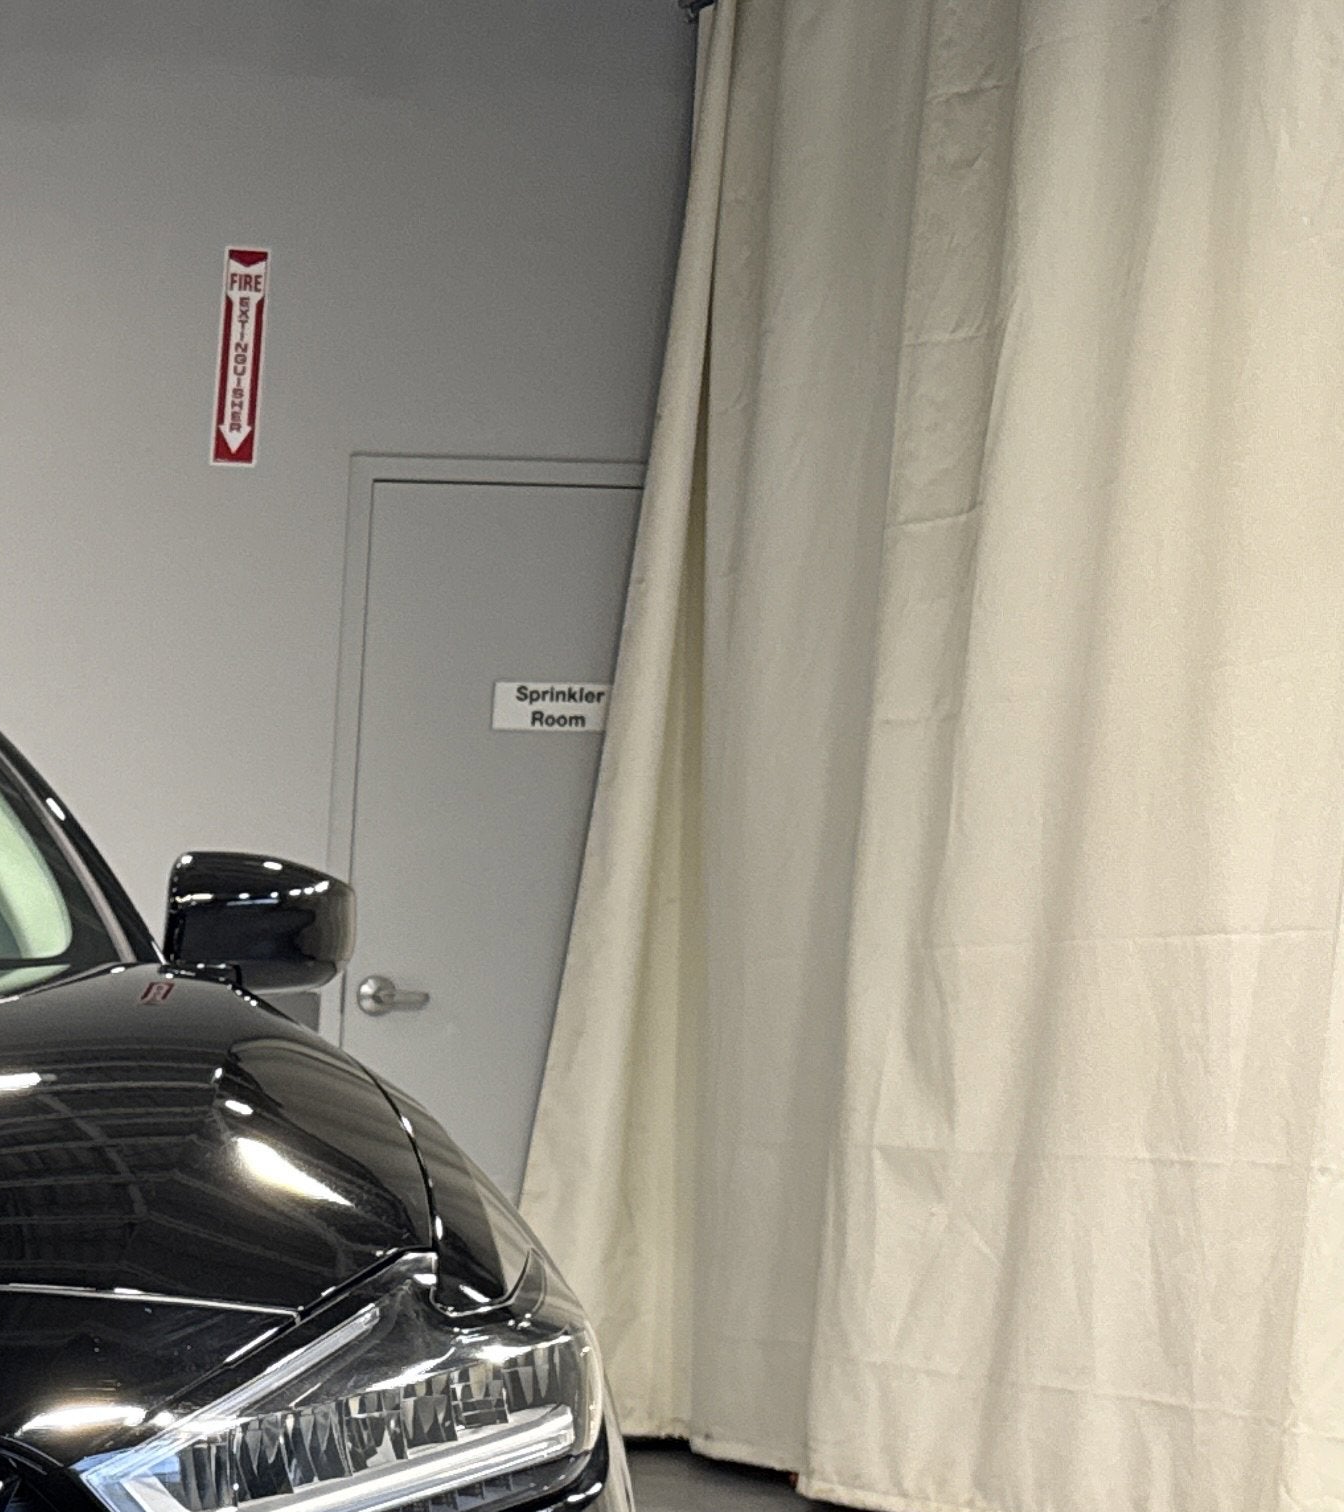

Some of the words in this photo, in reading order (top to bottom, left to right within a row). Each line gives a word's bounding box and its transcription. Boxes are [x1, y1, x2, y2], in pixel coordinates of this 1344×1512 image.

[229, 273, 263, 292] FIRE
[229, 297, 250, 433] EXTINGUISHER
[515, 685, 605, 705] Sprinkler
[530, 710, 586, 727] Room
